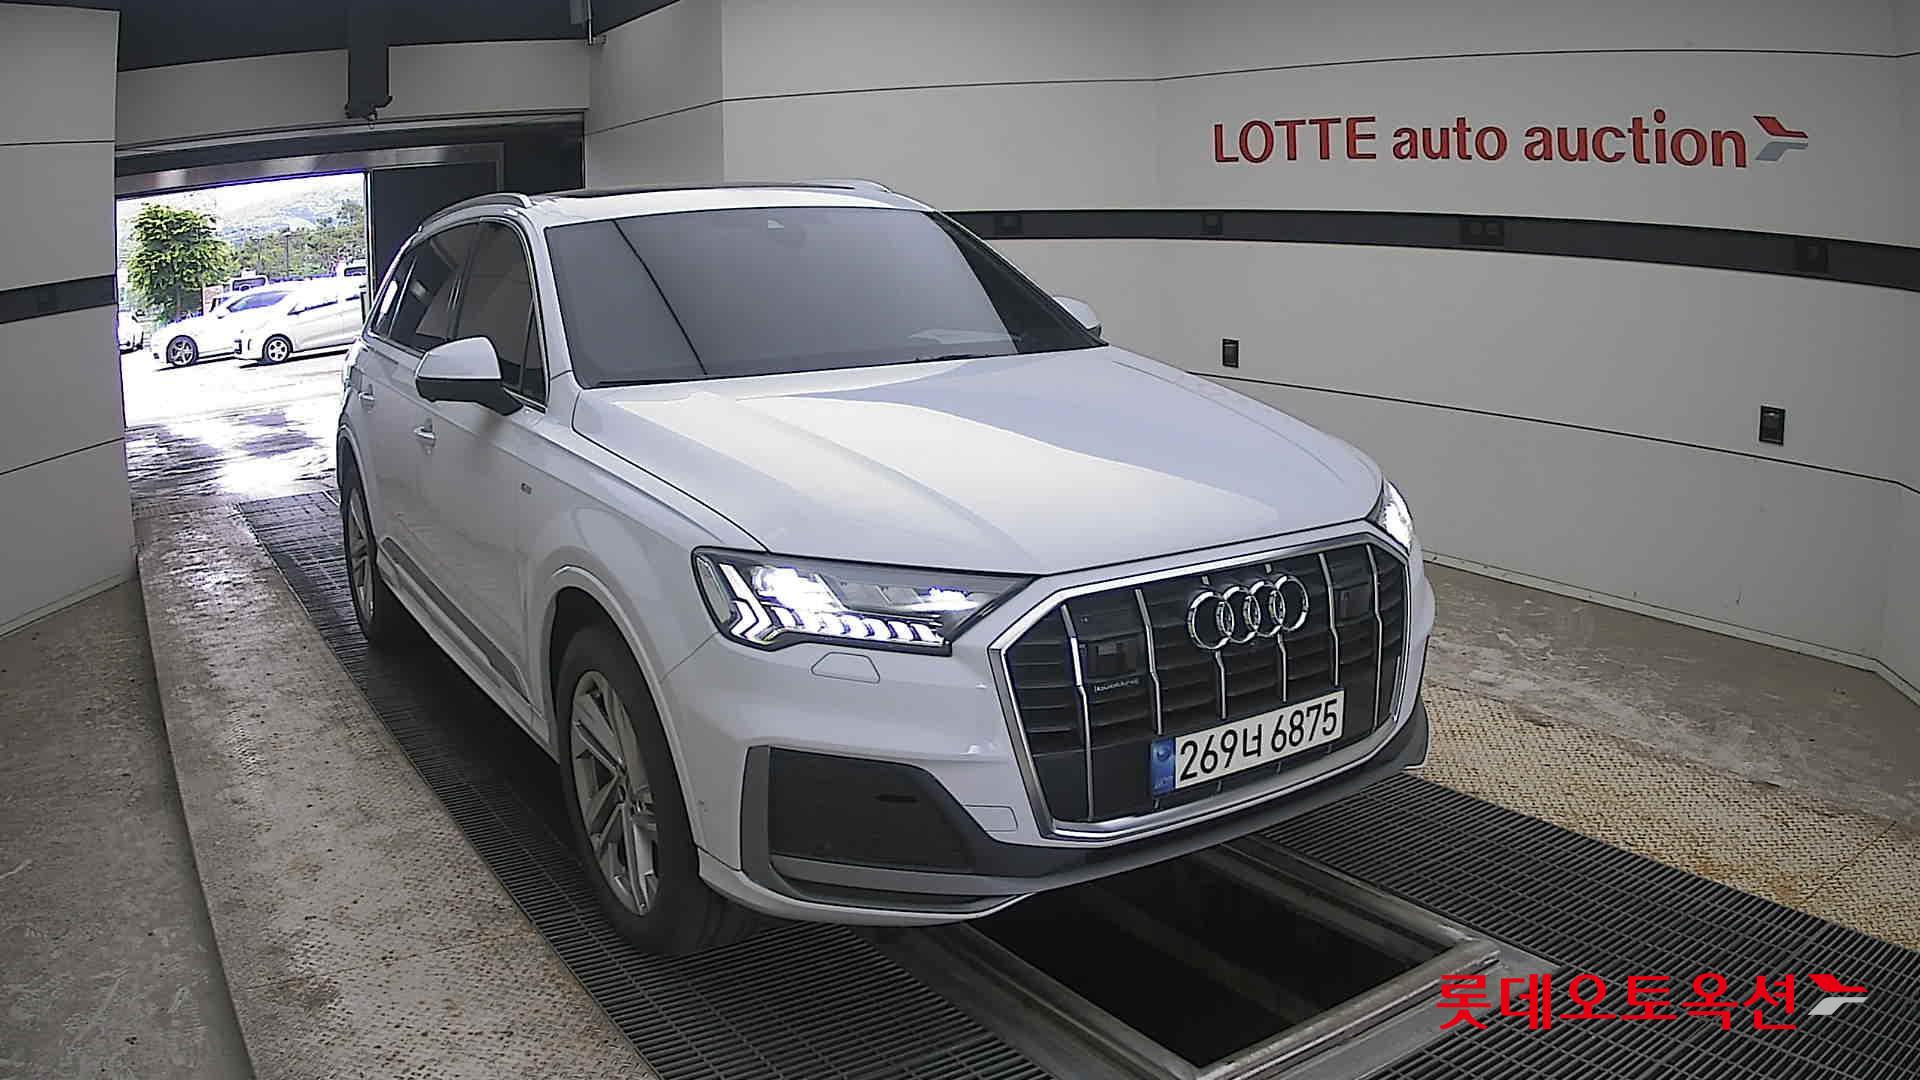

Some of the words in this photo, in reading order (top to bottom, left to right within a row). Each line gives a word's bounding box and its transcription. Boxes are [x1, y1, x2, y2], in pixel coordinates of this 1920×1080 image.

[1213, 116, 1377, 164] LOTTE
[1392, 116, 1508, 161] auto
[1523, 109, 1747, 168] auction
[1179, 723, 1262, 782] 269너
[1271, 699, 1338, 753] 6875
